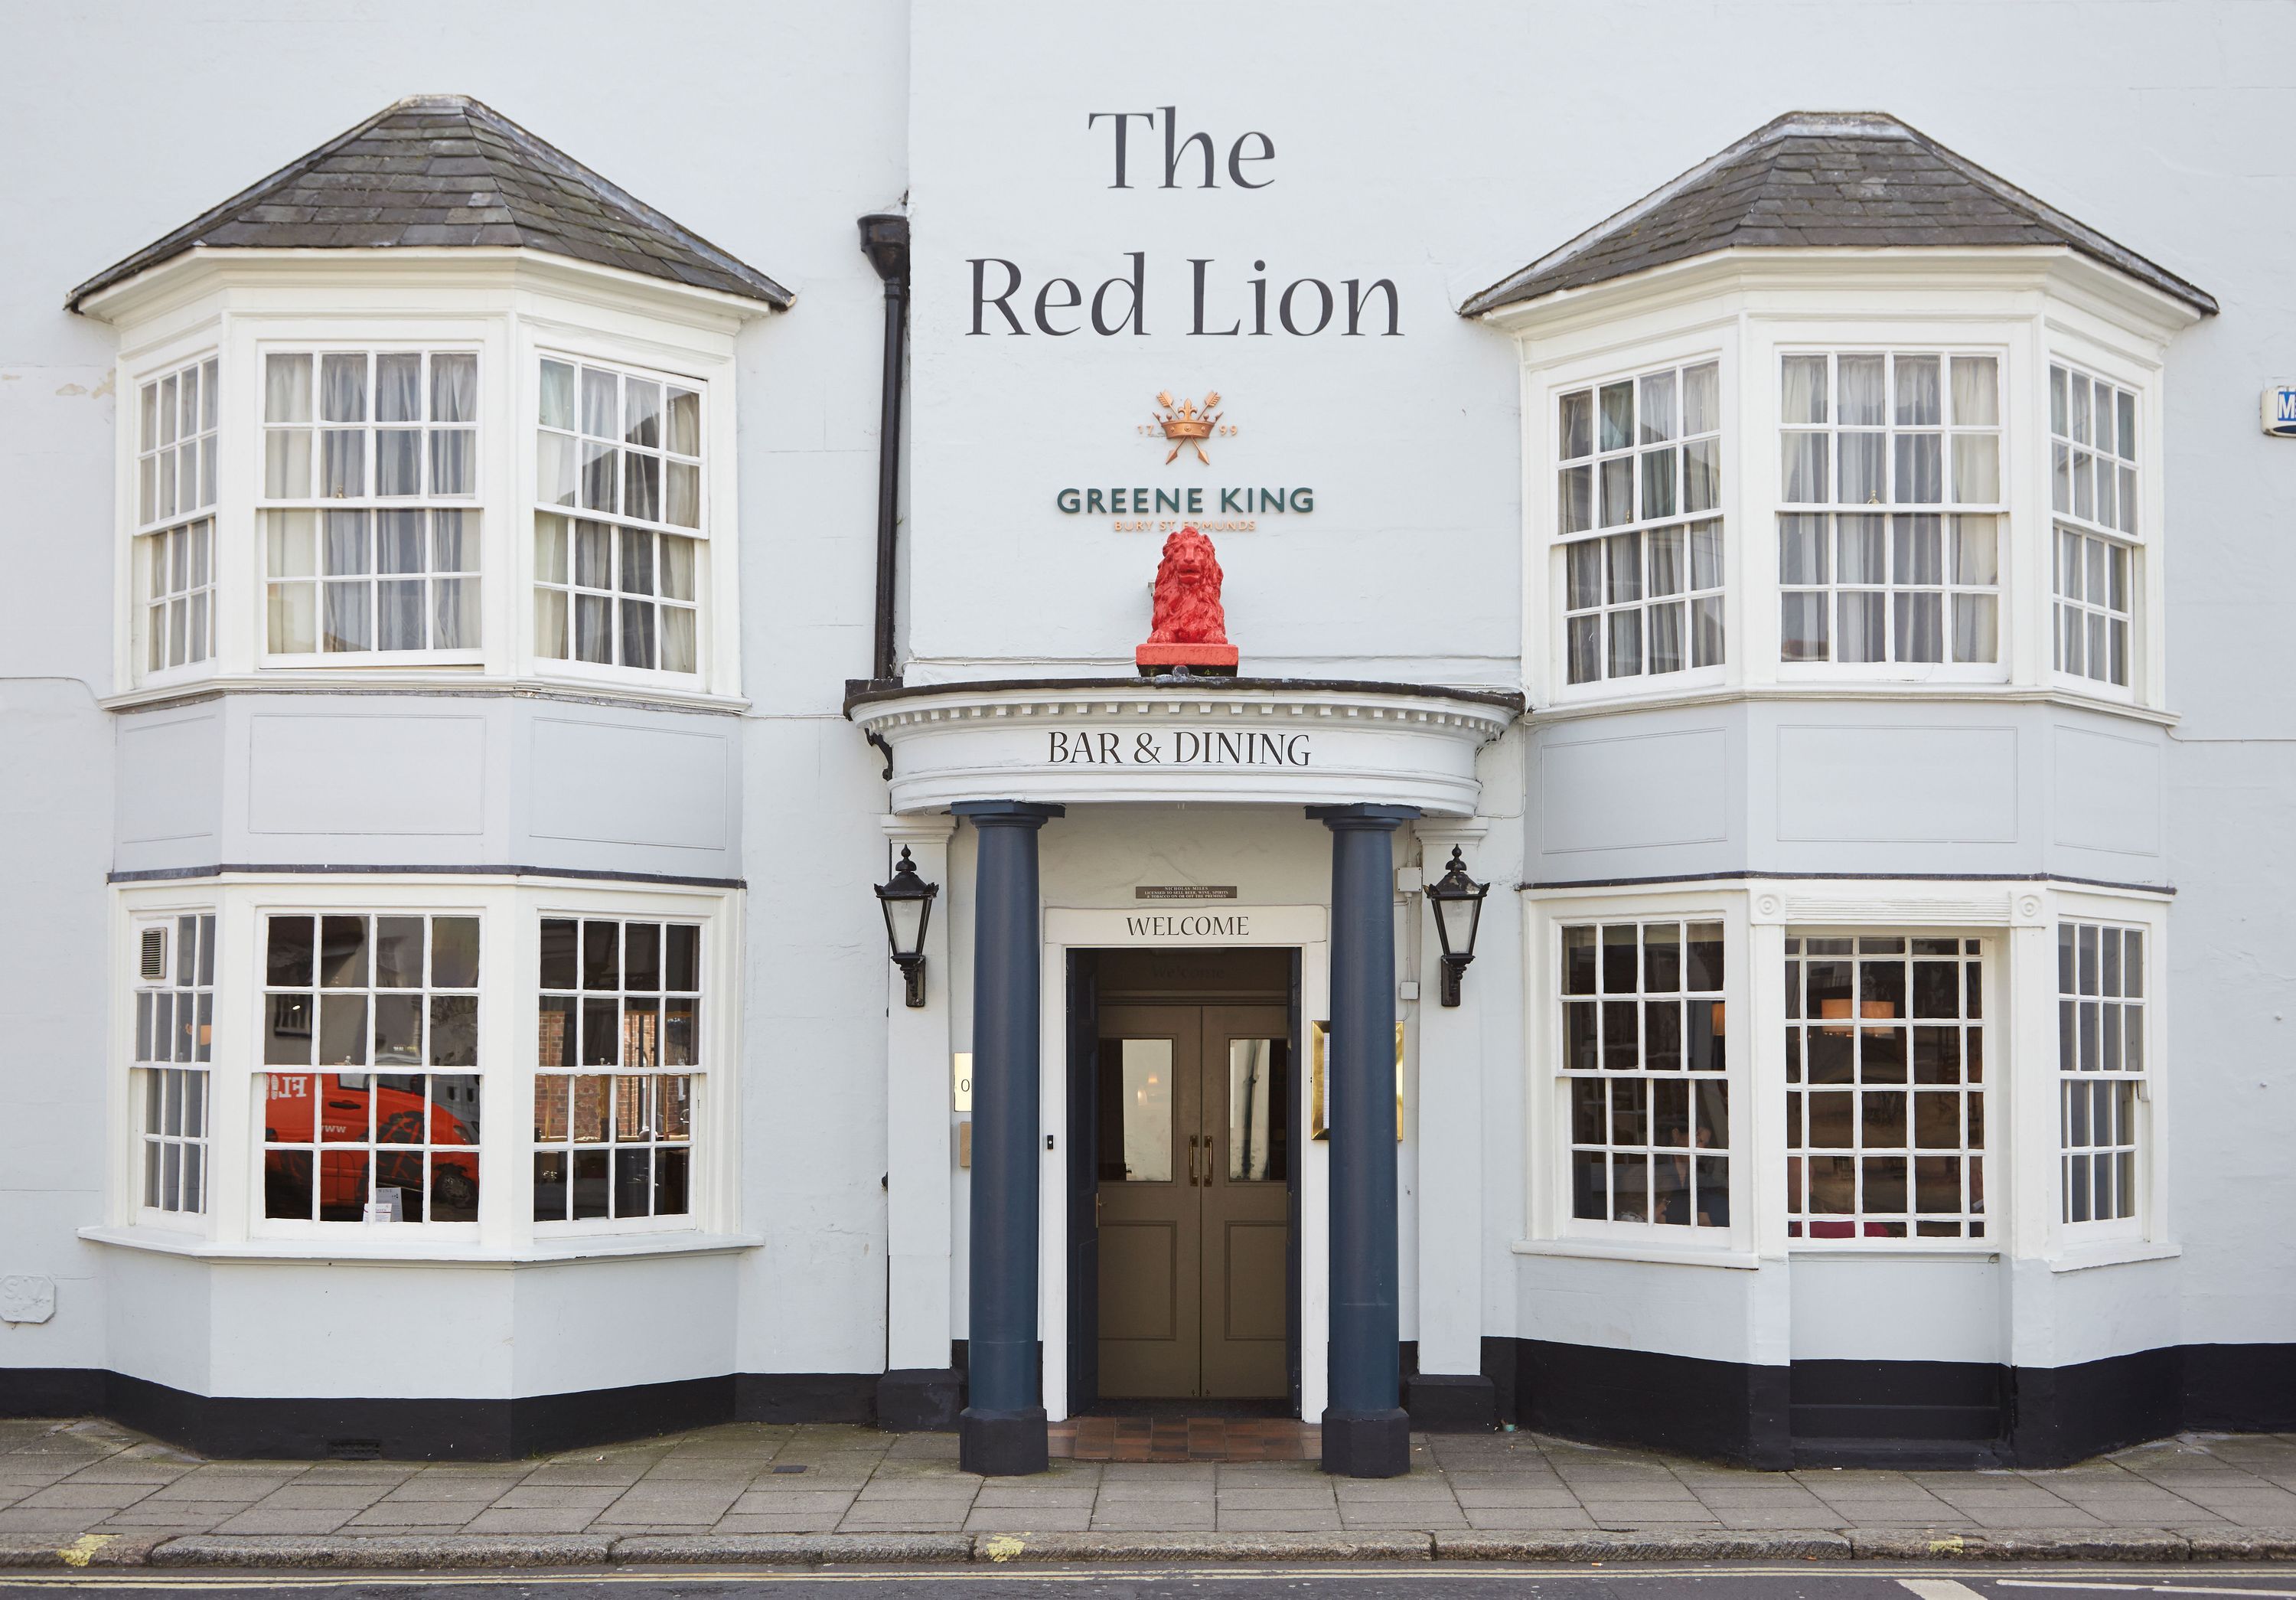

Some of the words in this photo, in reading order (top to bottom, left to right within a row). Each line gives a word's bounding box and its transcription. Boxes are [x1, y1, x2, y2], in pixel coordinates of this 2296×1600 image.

[1088, 106, 1276, 189] The
[964, 251, 1152, 336] Red
[1186, 259, 1406, 336] Lion
[1218, 424, 1238, 436] 99
[1057, 488, 1204, 514] GREENE
[1221, 487, 1314, 514] KING
[1114, 521, 1153, 531] BURY
[1159, 521, 1176, 531] ST
[1182, 520, 1256, 531] EDMUNDS
[1048, 731, 1124, 764] BAR
[1133, 732, 1162, 764] &
[1173, 731, 1312, 766] DINING
[1126, 916, 1250, 936] WELCOME
